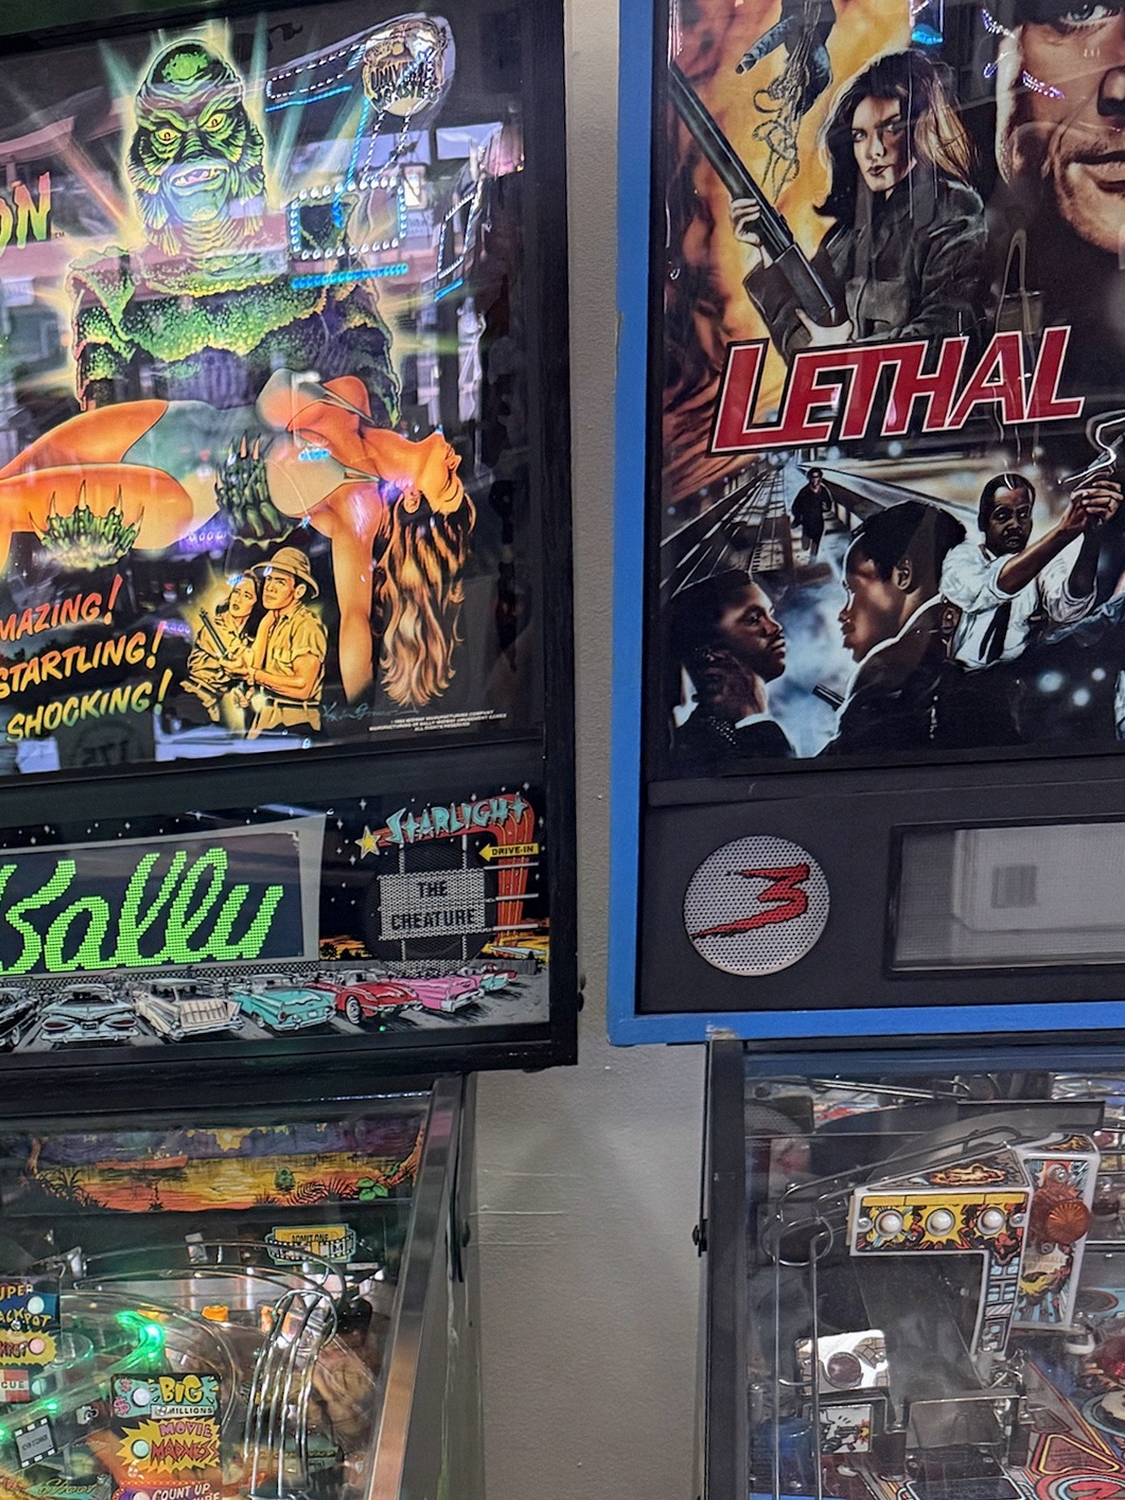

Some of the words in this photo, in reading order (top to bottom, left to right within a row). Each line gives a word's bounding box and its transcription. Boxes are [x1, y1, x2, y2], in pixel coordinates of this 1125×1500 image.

[711, 325, 1087, 455] LETHAL
[6, 669, 173, 745] SHOCKING!
[385, 792, 527, 844] STARLIGHT
[492, 845, 534, 856] DRIVE-IN
[417, 881, 448, 897] THE
[391, 909, 478, 930] CREATURE
[158, 1374, 203, 1404] BIG
[158, 1421, 213, 1438] MOVIE
[150, 1438, 220, 1464] MADNESS
[194, 1482, 211, 1495] UP
